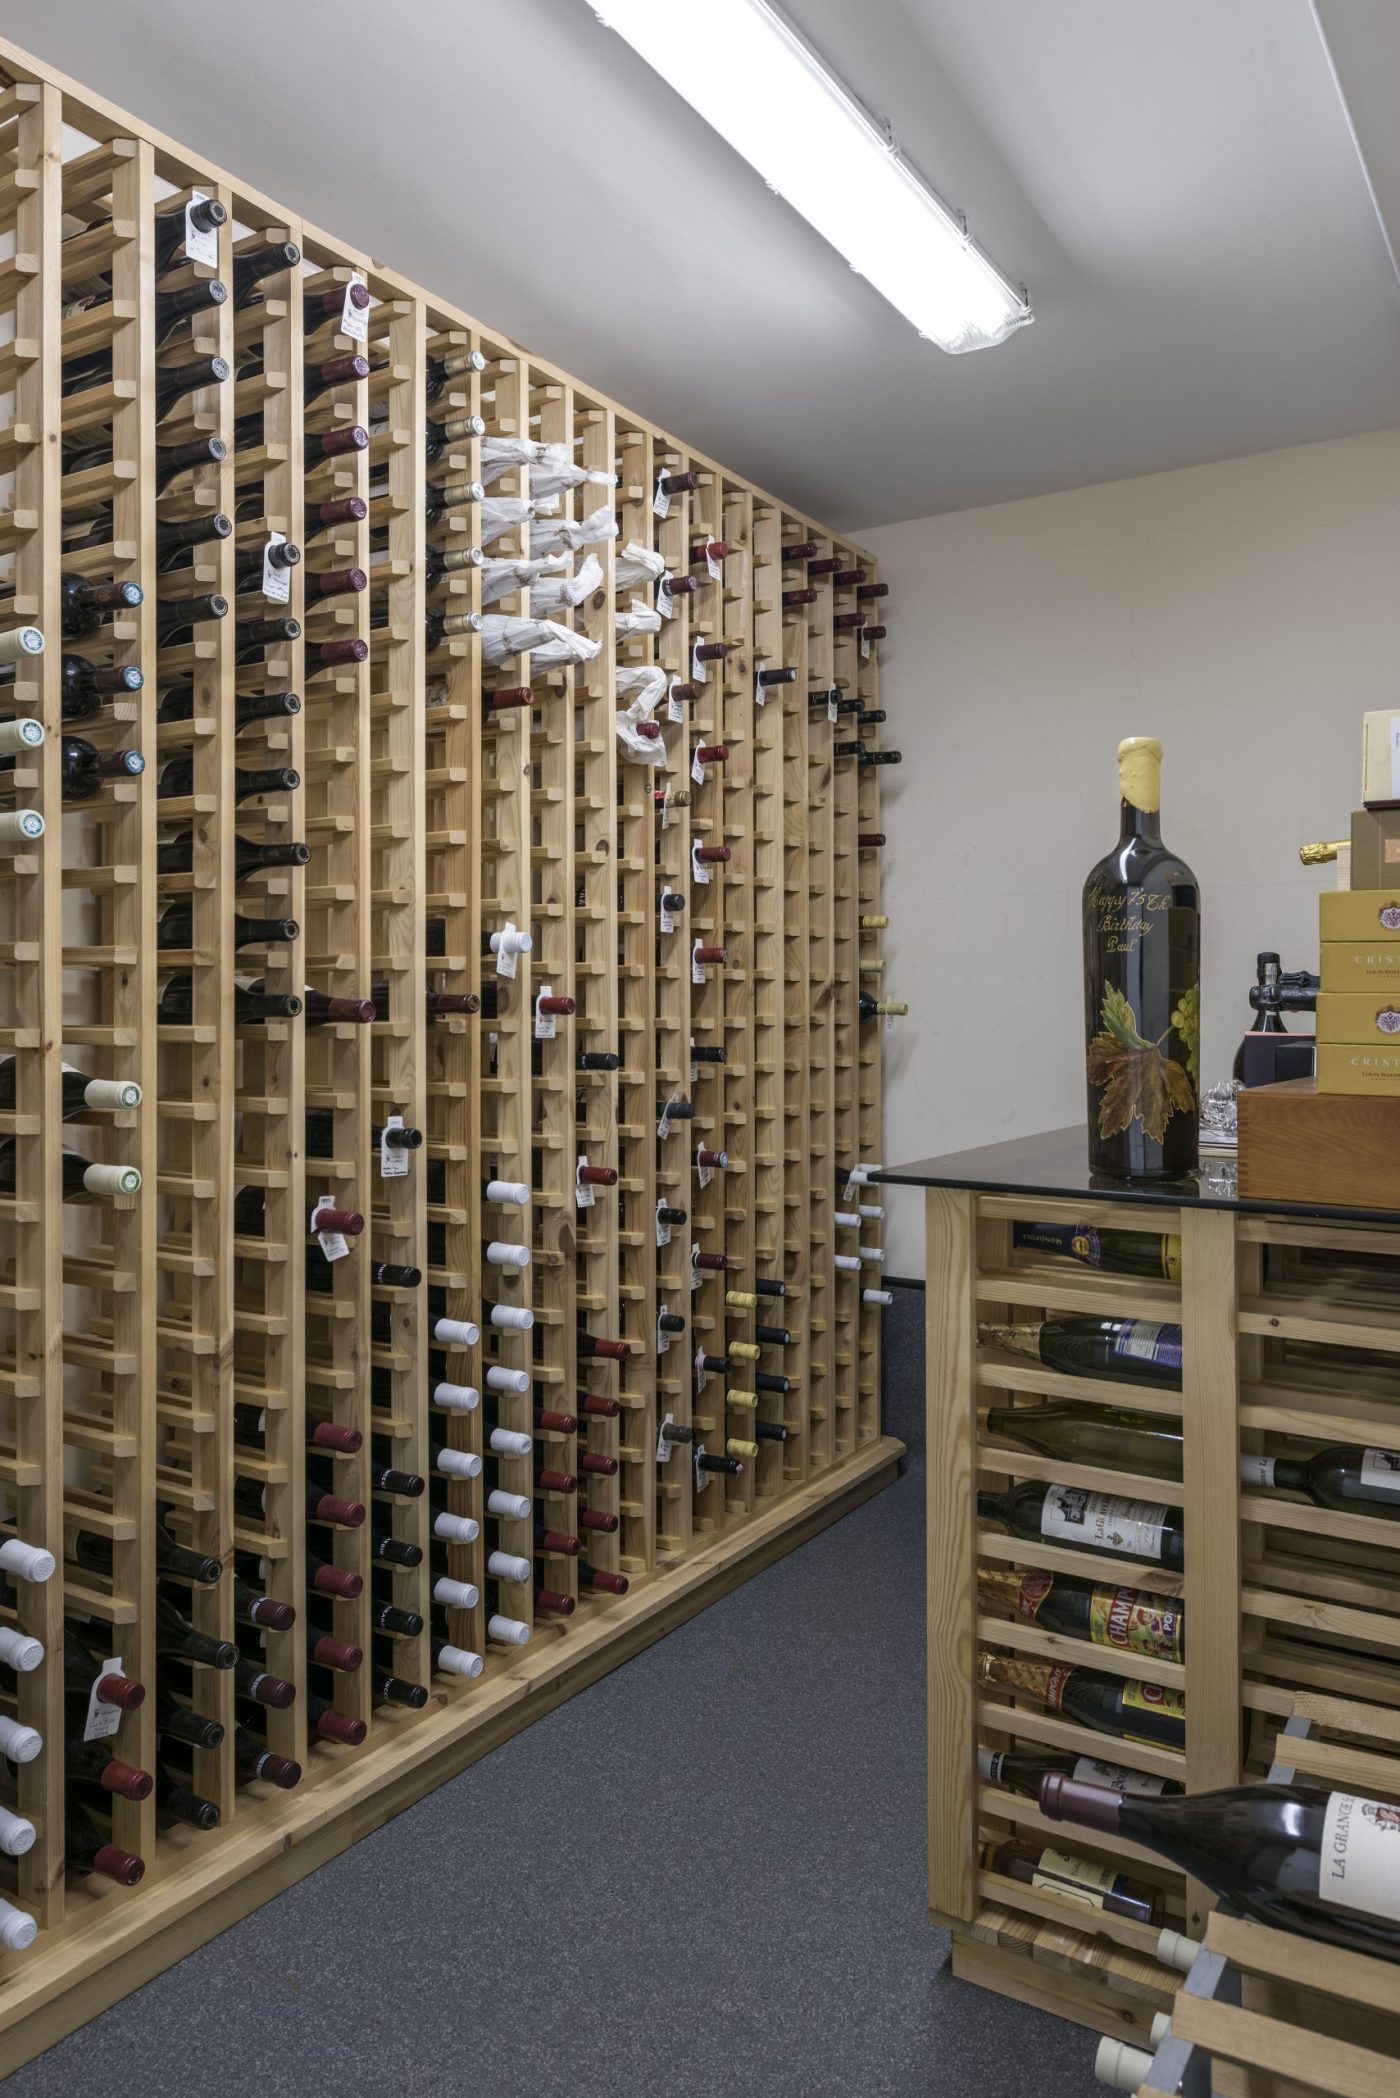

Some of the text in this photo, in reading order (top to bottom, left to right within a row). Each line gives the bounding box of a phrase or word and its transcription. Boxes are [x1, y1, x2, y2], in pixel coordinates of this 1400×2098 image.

[1089, 884, 1126, 912] Happy
[1096, 915, 1153, 937] Birthday
[1106, 936, 1137, 953] Paul
[1331, 1859, 1346, 1879] LA
